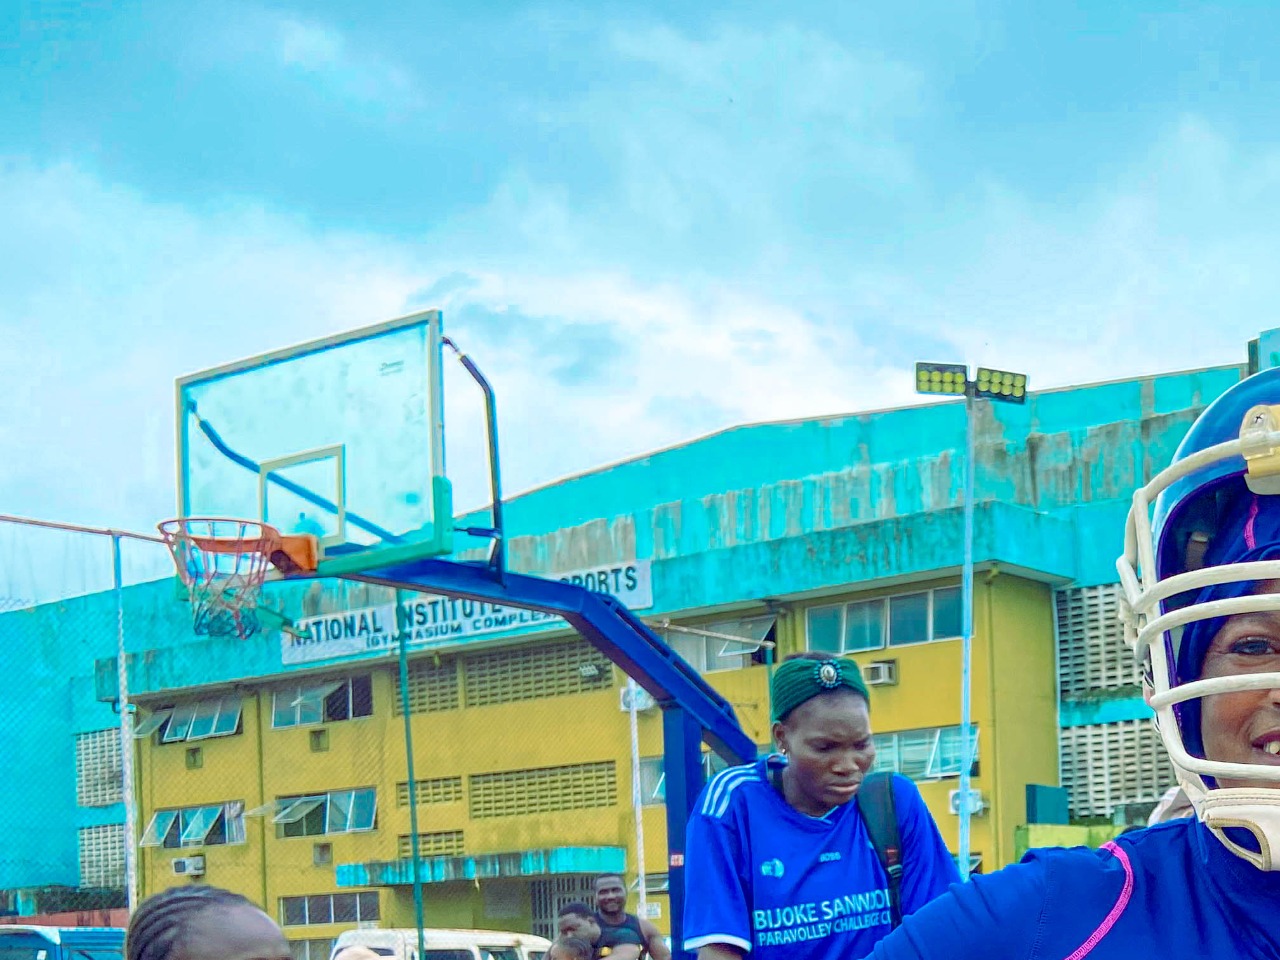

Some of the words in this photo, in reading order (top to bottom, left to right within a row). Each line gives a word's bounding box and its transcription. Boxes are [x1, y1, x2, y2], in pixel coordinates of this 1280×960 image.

[290, 610, 383, 648] NATIONAL
[396, 598, 502, 629] NSTITUTE
[758, 922, 832, 946] PARAVOLLEY
